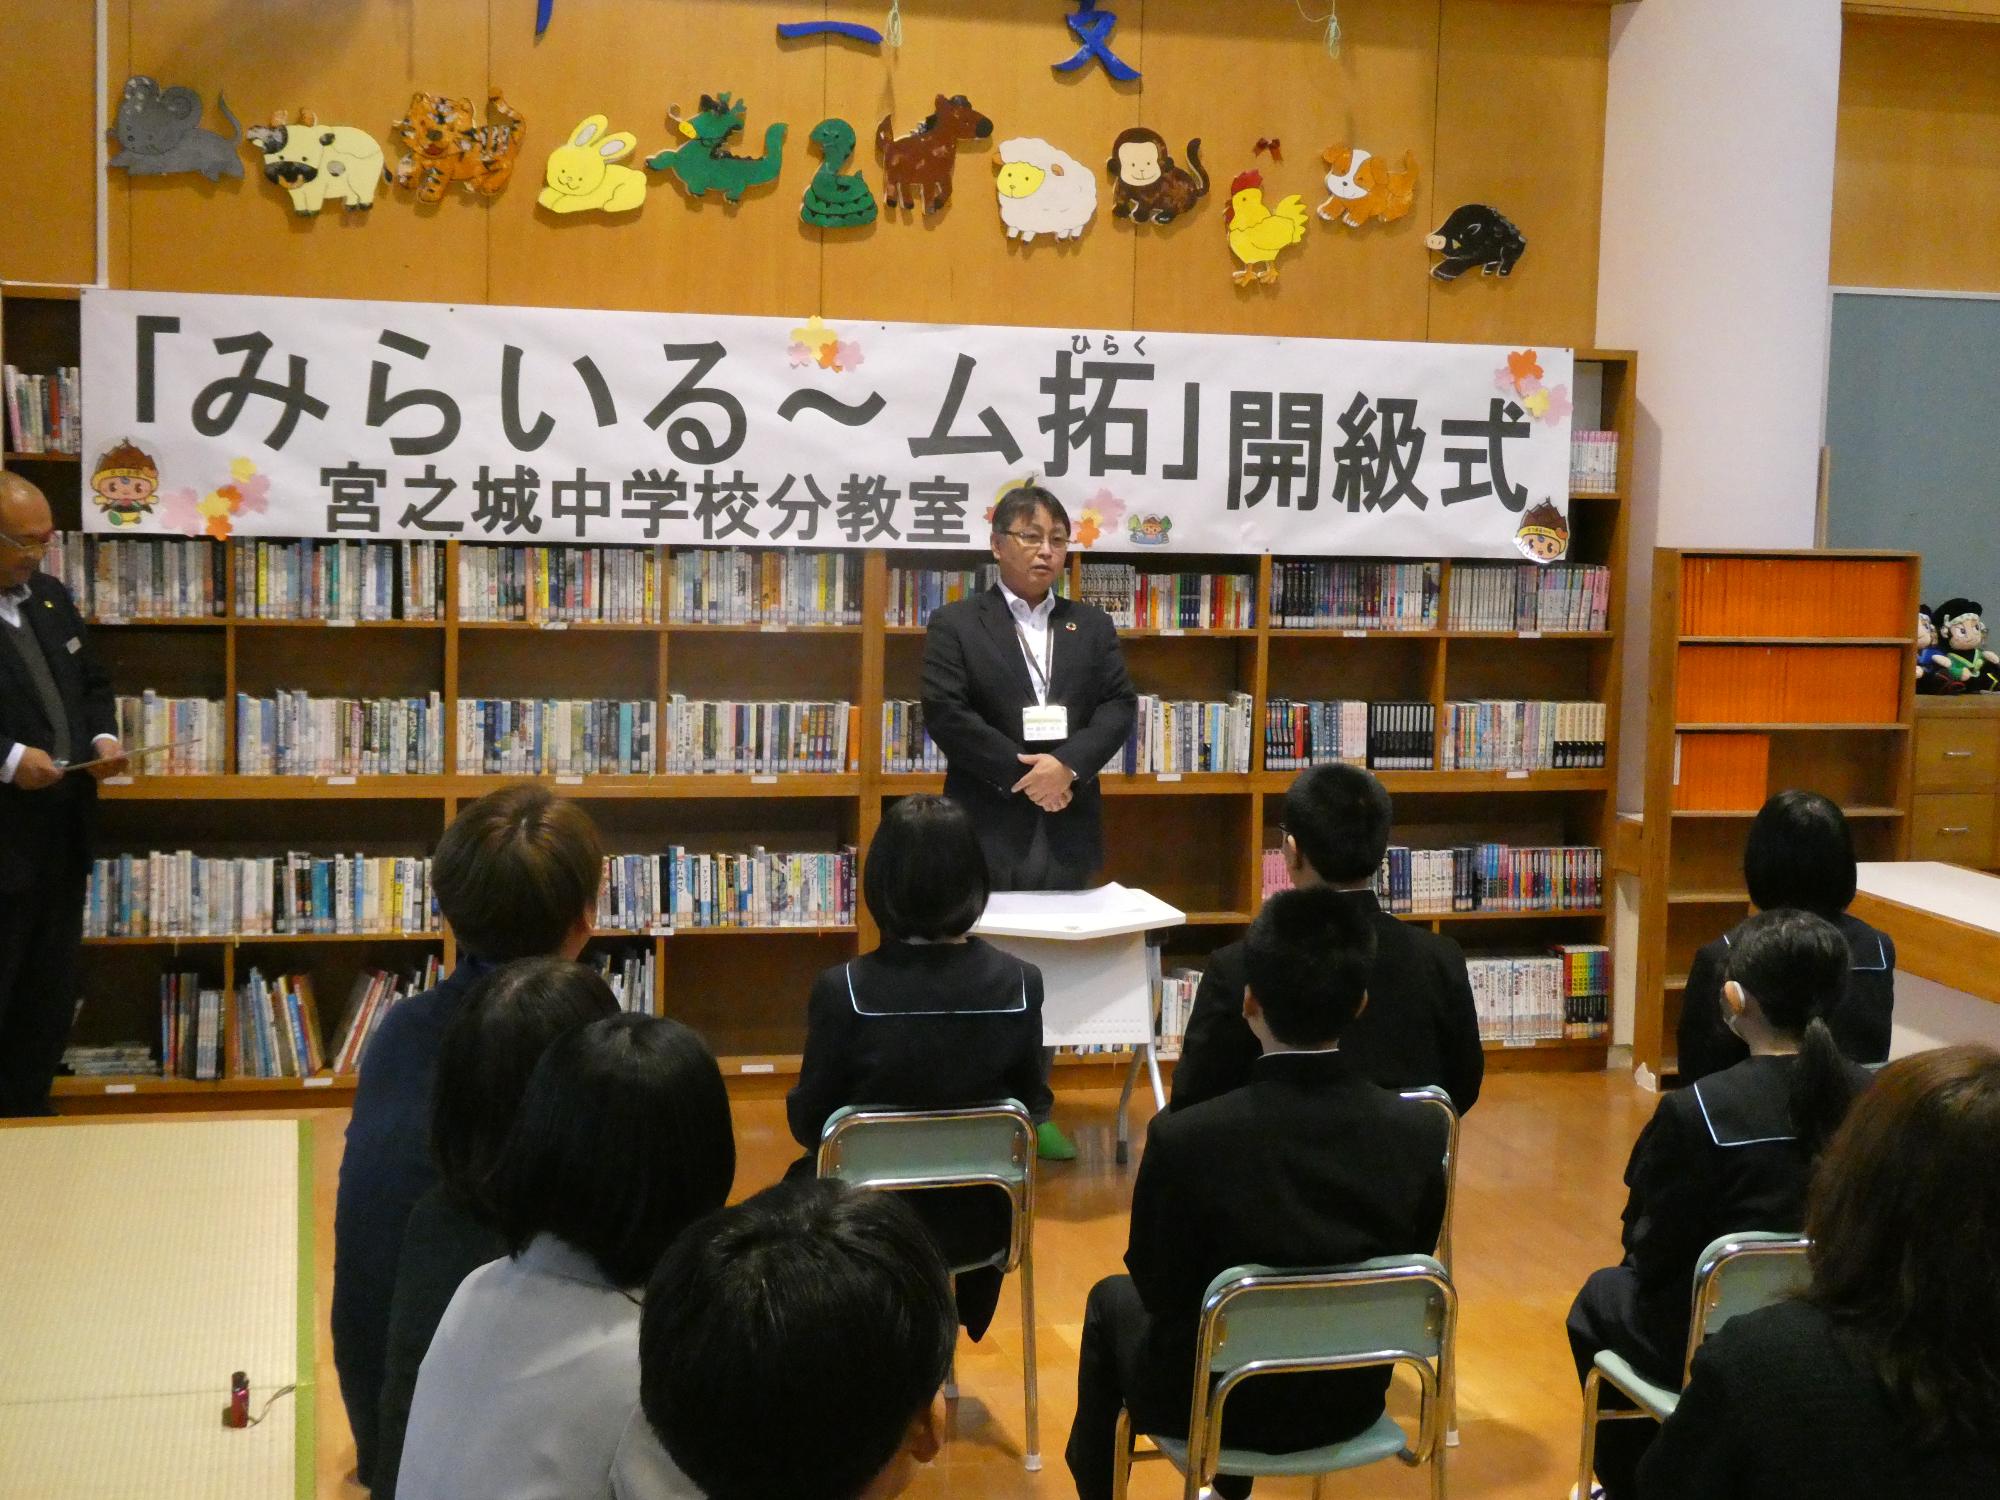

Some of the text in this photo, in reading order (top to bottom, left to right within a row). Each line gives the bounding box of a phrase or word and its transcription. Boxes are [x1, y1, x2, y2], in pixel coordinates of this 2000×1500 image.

[1071, 334, 1148, 357] ひらく
[321, 461, 971, 546] 宮之城中学校分教室
